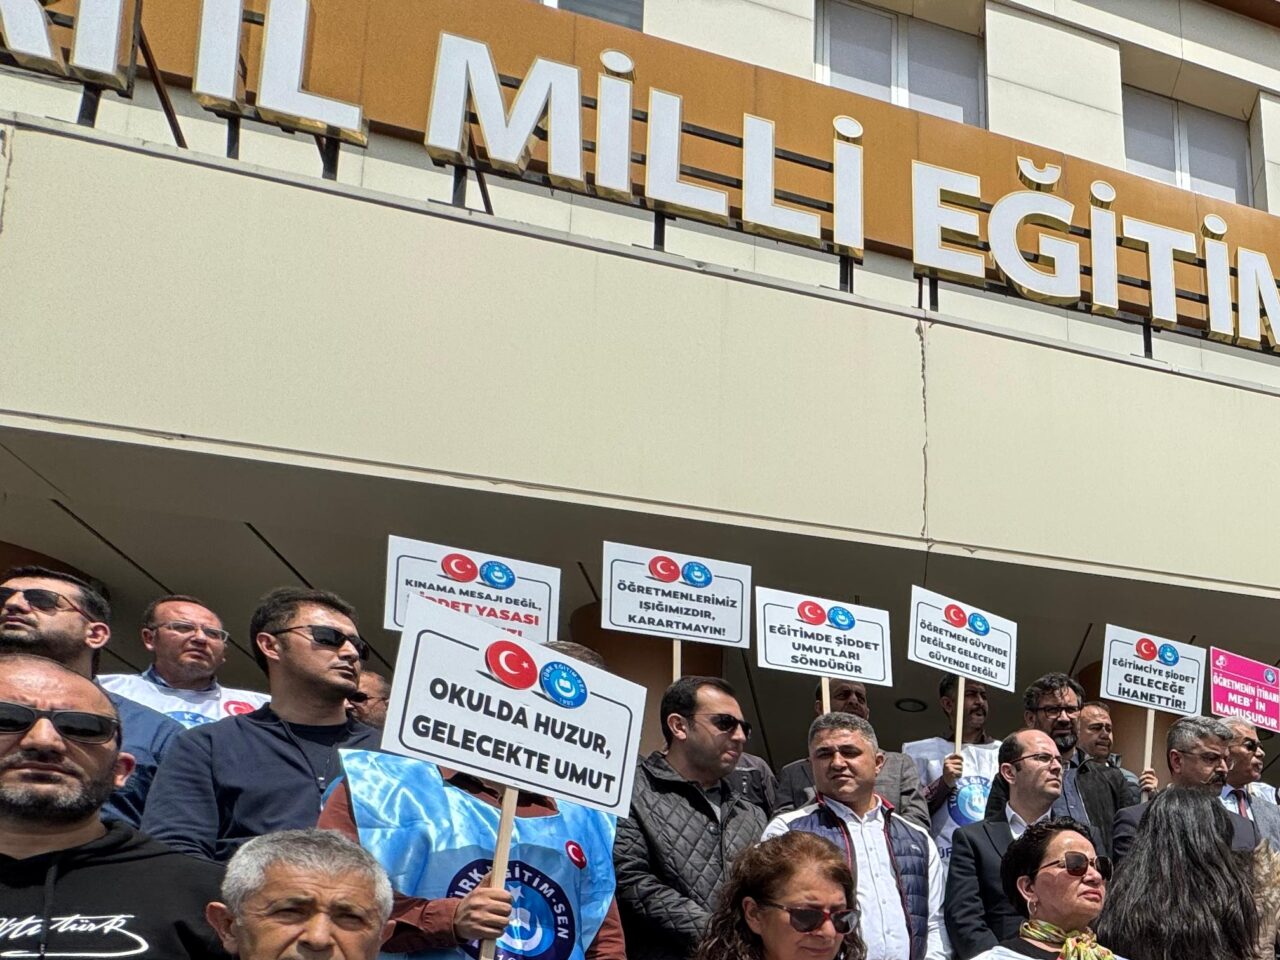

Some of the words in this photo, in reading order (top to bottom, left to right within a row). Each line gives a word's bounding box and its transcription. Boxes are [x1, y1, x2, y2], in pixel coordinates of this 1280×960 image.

[424, 31, 865, 254] MİLLİ
[405, 578, 456, 595] KINAMA
[459, 588, 503, 603] MESAJI
[505, 597, 542, 611] DEĞİL,
[617, 579, 738, 608] ÖĞRETMENLERİMİZ
[476, 604, 540, 626] YASASI
[639, 600, 716, 621] IŞIĞIMIZDIR,
[628, 614, 726, 636] KARARTMAYIN!
[768, 623, 833, 643] EĞİTİMDE
[835, 633, 880, 651] ŞİDDET
[919, 619, 968, 645] ÖĞRETMEN
[969, 636, 1008, 658] GÜVENDE
[790, 653, 863, 674] SÖNDÜRÜR
[791, 641, 860, 661] UMUTLARI
[920, 634, 956, 654] DEĞİLSE
[957, 647, 993, 666] GELECEK
[995, 659, 1006, 670] DE
[928, 650, 970, 672] GÜVENDE
[971, 662, 998, 680] DEĞİL!
[1112, 657, 1164, 677] EĞİTİMCİYE
[1165, 670, 1196, 684] ŞİDDET
[1118, 683, 1186, 710] İHANETTİR!
[1124, 673, 1185, 695] GELECEĞE
[1212, 672, 1256, 695] ÖĞRETMENİN
[429, 676, 529, 729] OKULDA
[534, 712, 612, 759] HUZUR,
[412, 714, 549, 775] GELECEKTE
[554, 757, 616, 793] UMUT
